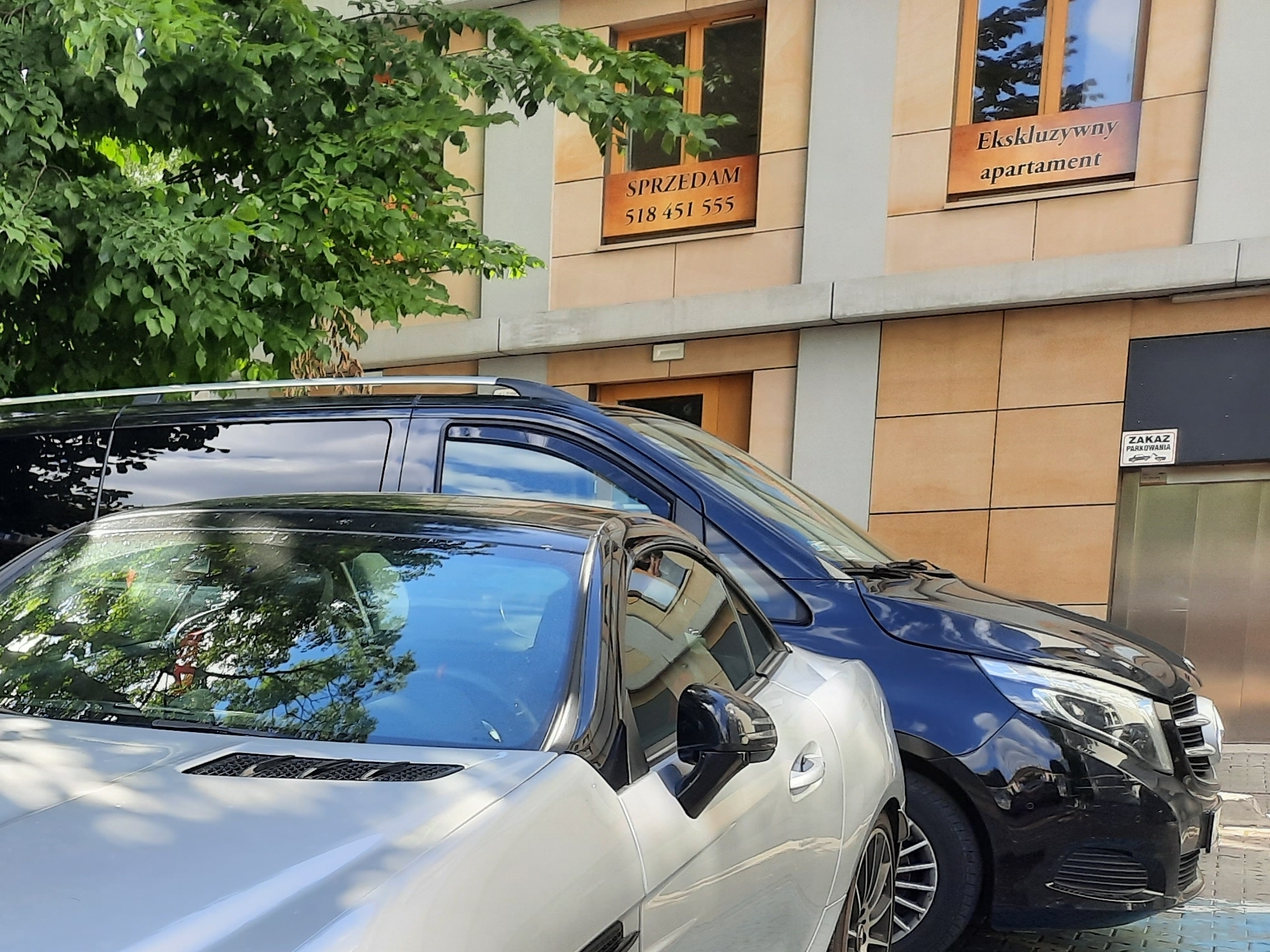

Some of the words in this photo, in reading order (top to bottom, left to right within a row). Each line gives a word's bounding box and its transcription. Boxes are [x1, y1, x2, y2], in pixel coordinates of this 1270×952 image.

[976, 120, 1119, 150] Ekskluzywny
[626, 166, 742, 198] SPRZEDAM
[980, 152, 1102, 185] apartament
[625, 206, 657, 226] 518
[662, 202, 693, 220] 451
[702, 196, 735, 216] 555
[1126, 444, 1171, 452] PARKOWANIA
[1129, 435, 1171, 444] ZAKAZ
